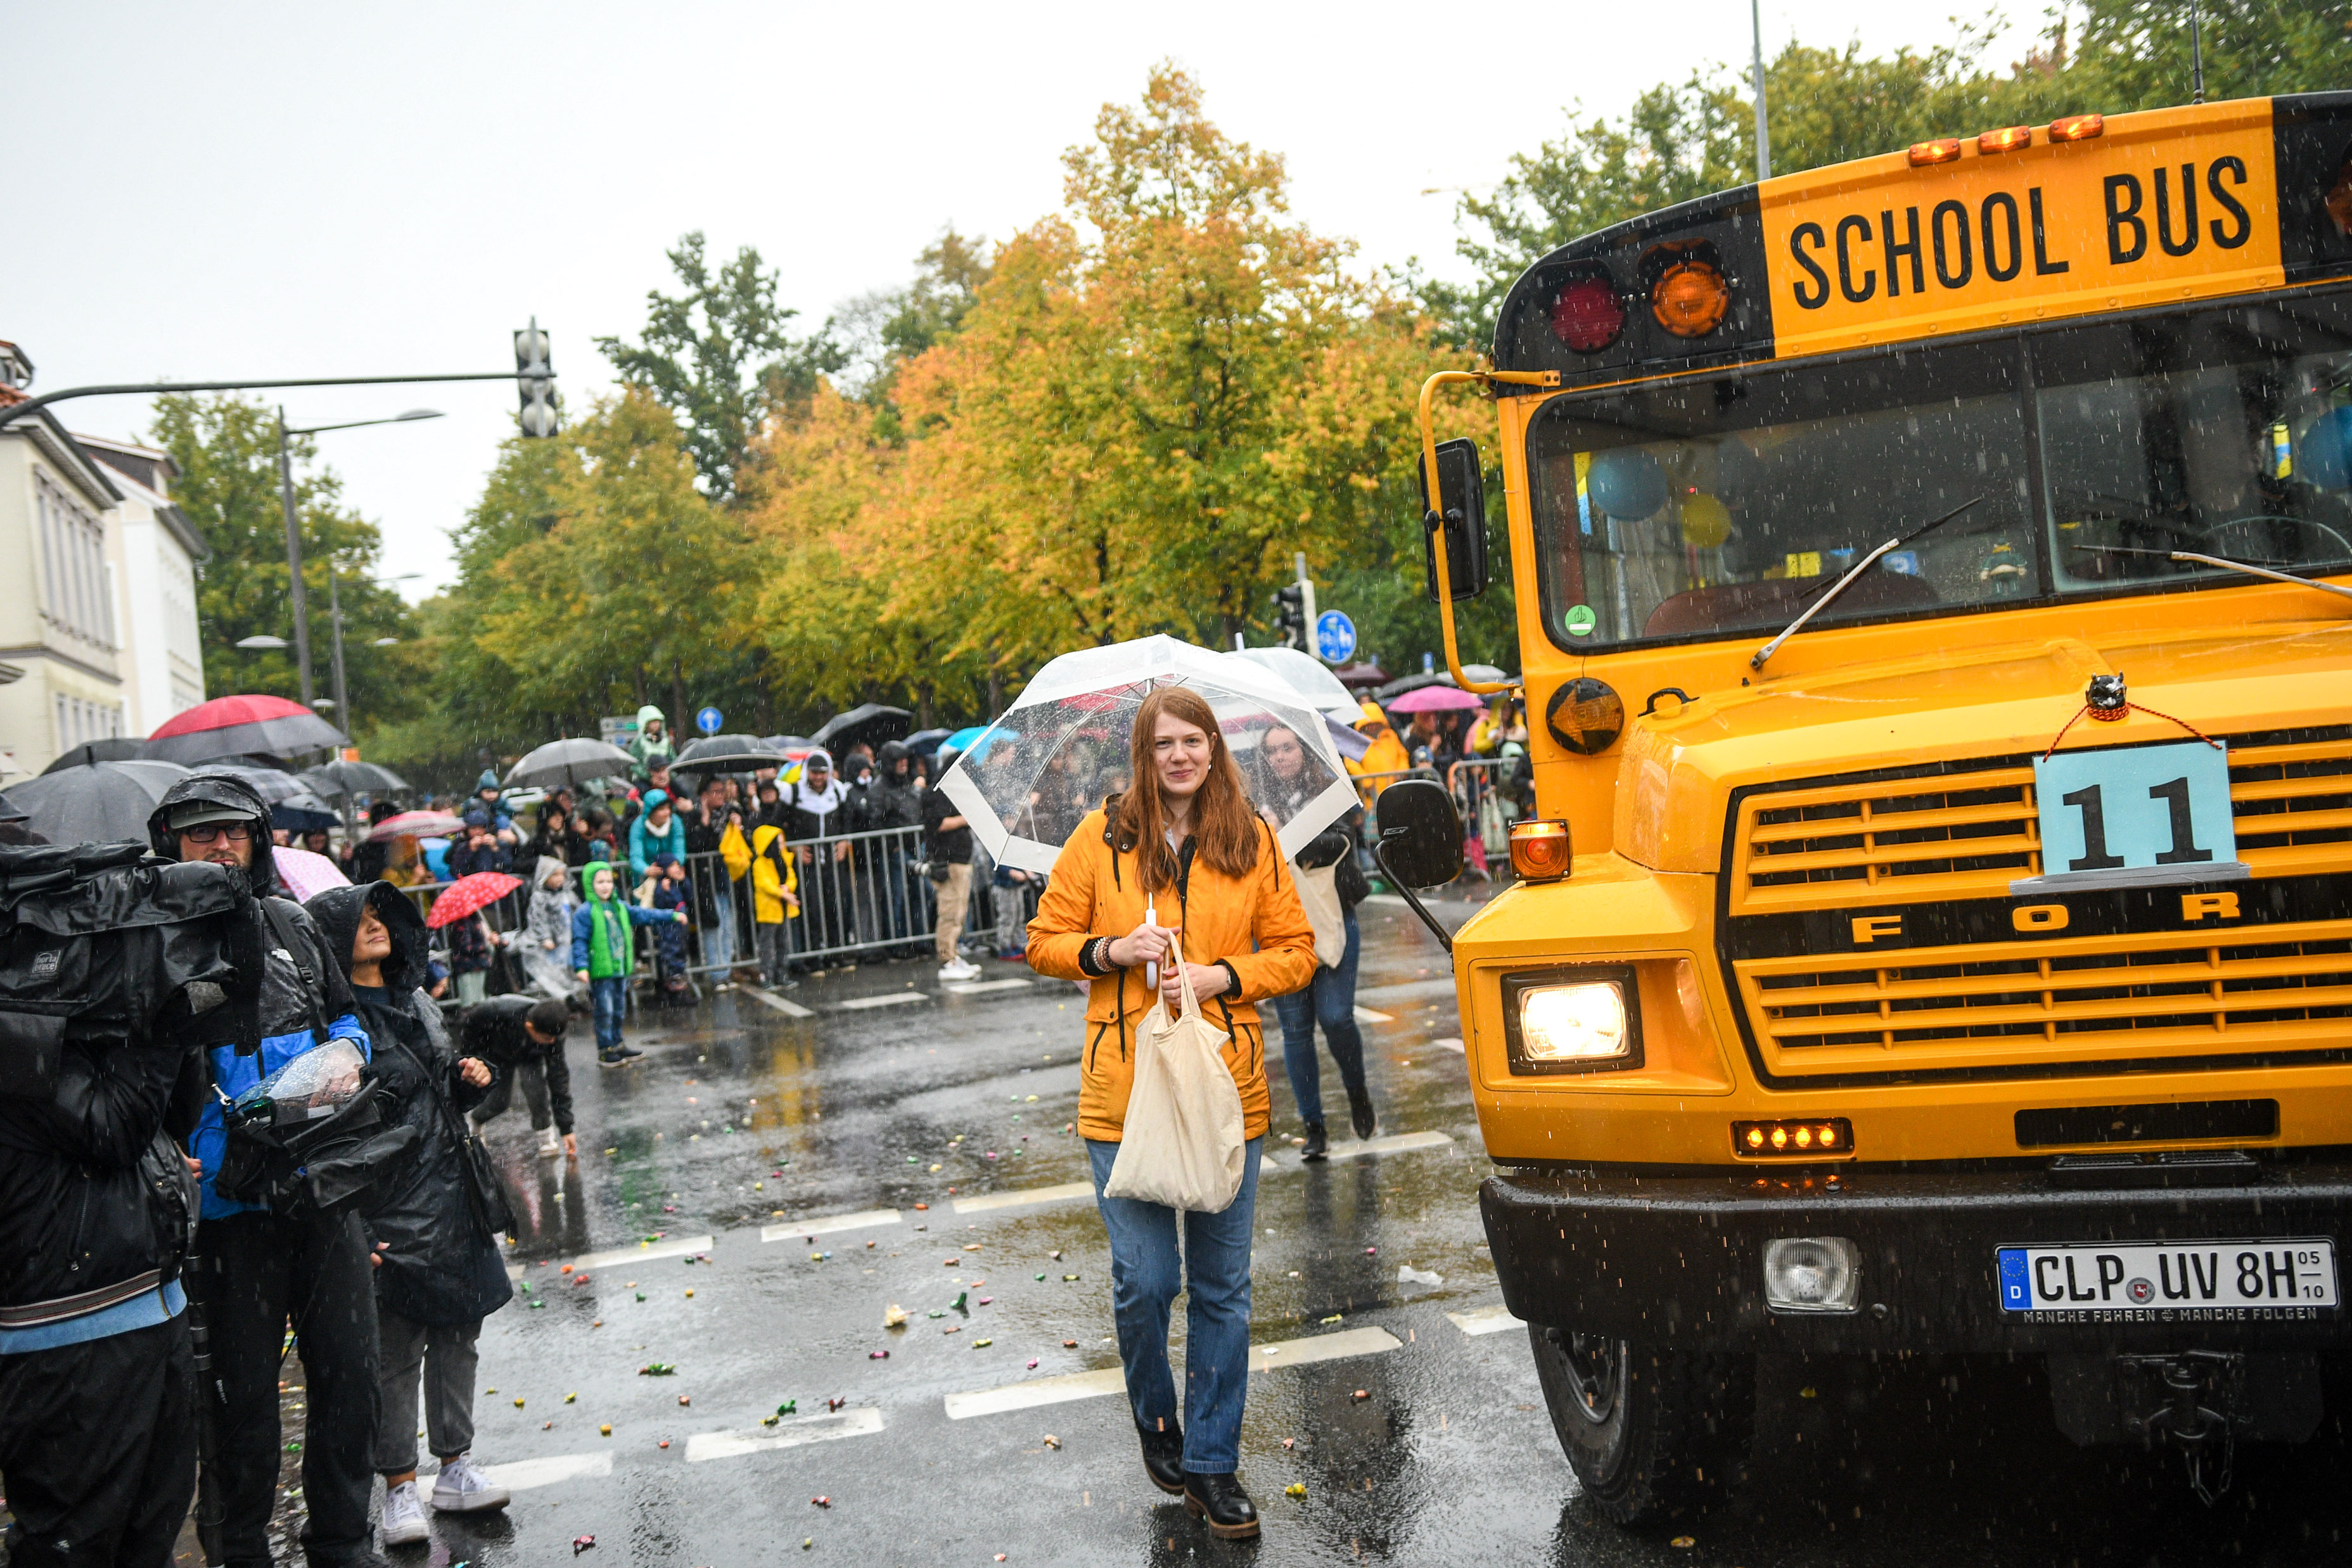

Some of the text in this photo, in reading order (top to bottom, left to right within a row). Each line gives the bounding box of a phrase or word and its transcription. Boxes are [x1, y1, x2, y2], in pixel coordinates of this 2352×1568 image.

[1791, 155, 2252, 309] SCHOOL BUS
[2062, 776, 2213, 872] 11
[2299, 1251, 2320, 1265] 05
[2035, 1251, 2298, 1301] CLP UV 8H
[2010, 1285, 2021, 1299] D
[2303, 1285, 2324, 1298] 10
[2023, 1311, 2087, 1323] MANCHE
[2180, 1308, 2246, 1321] MANCHE
[2253, 1307, 2317, 1320] FOLGEN
